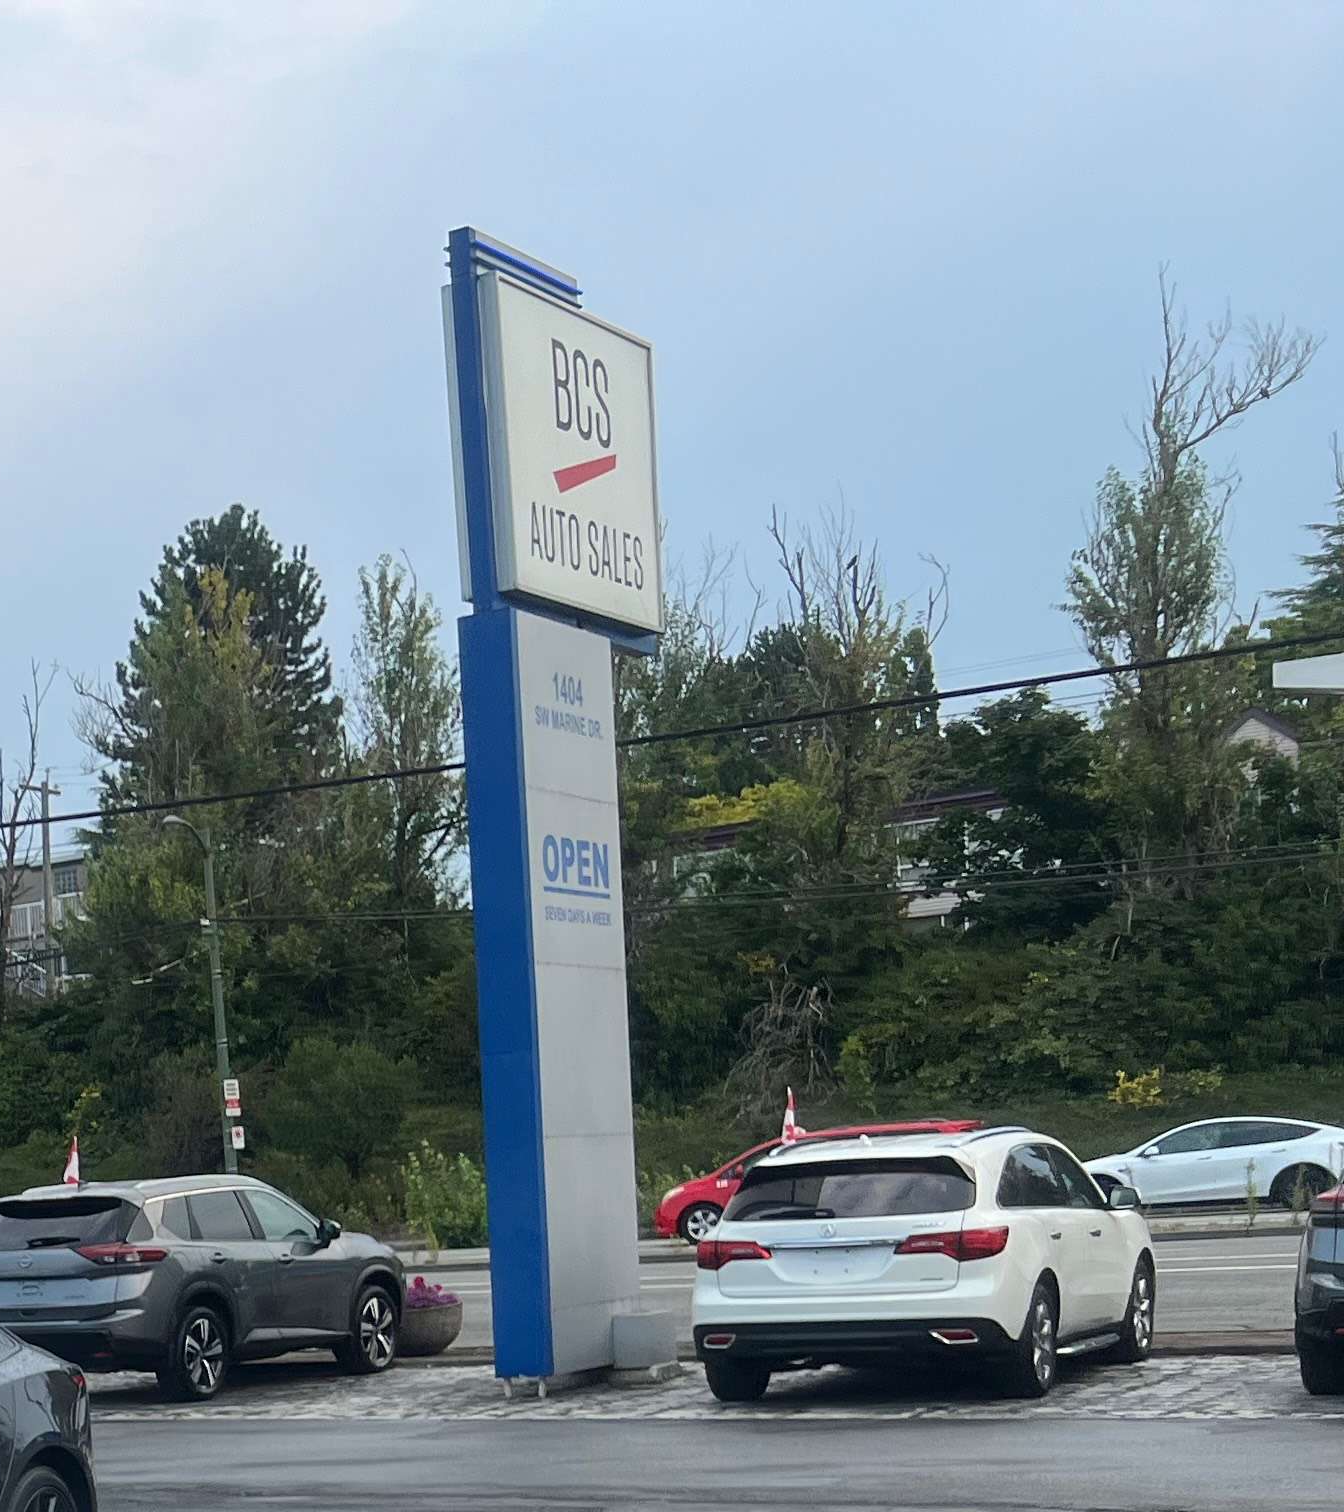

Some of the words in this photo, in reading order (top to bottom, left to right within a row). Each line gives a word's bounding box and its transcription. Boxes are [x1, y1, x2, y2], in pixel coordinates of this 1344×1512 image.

[551, 337, 611, 449] BCS
[531, 501, 581, 571] AUTO
[588, 520, 644, 590] SALES
[552, 672, 583, 707] 1404
[542, 834, 610, 889] OPEN
